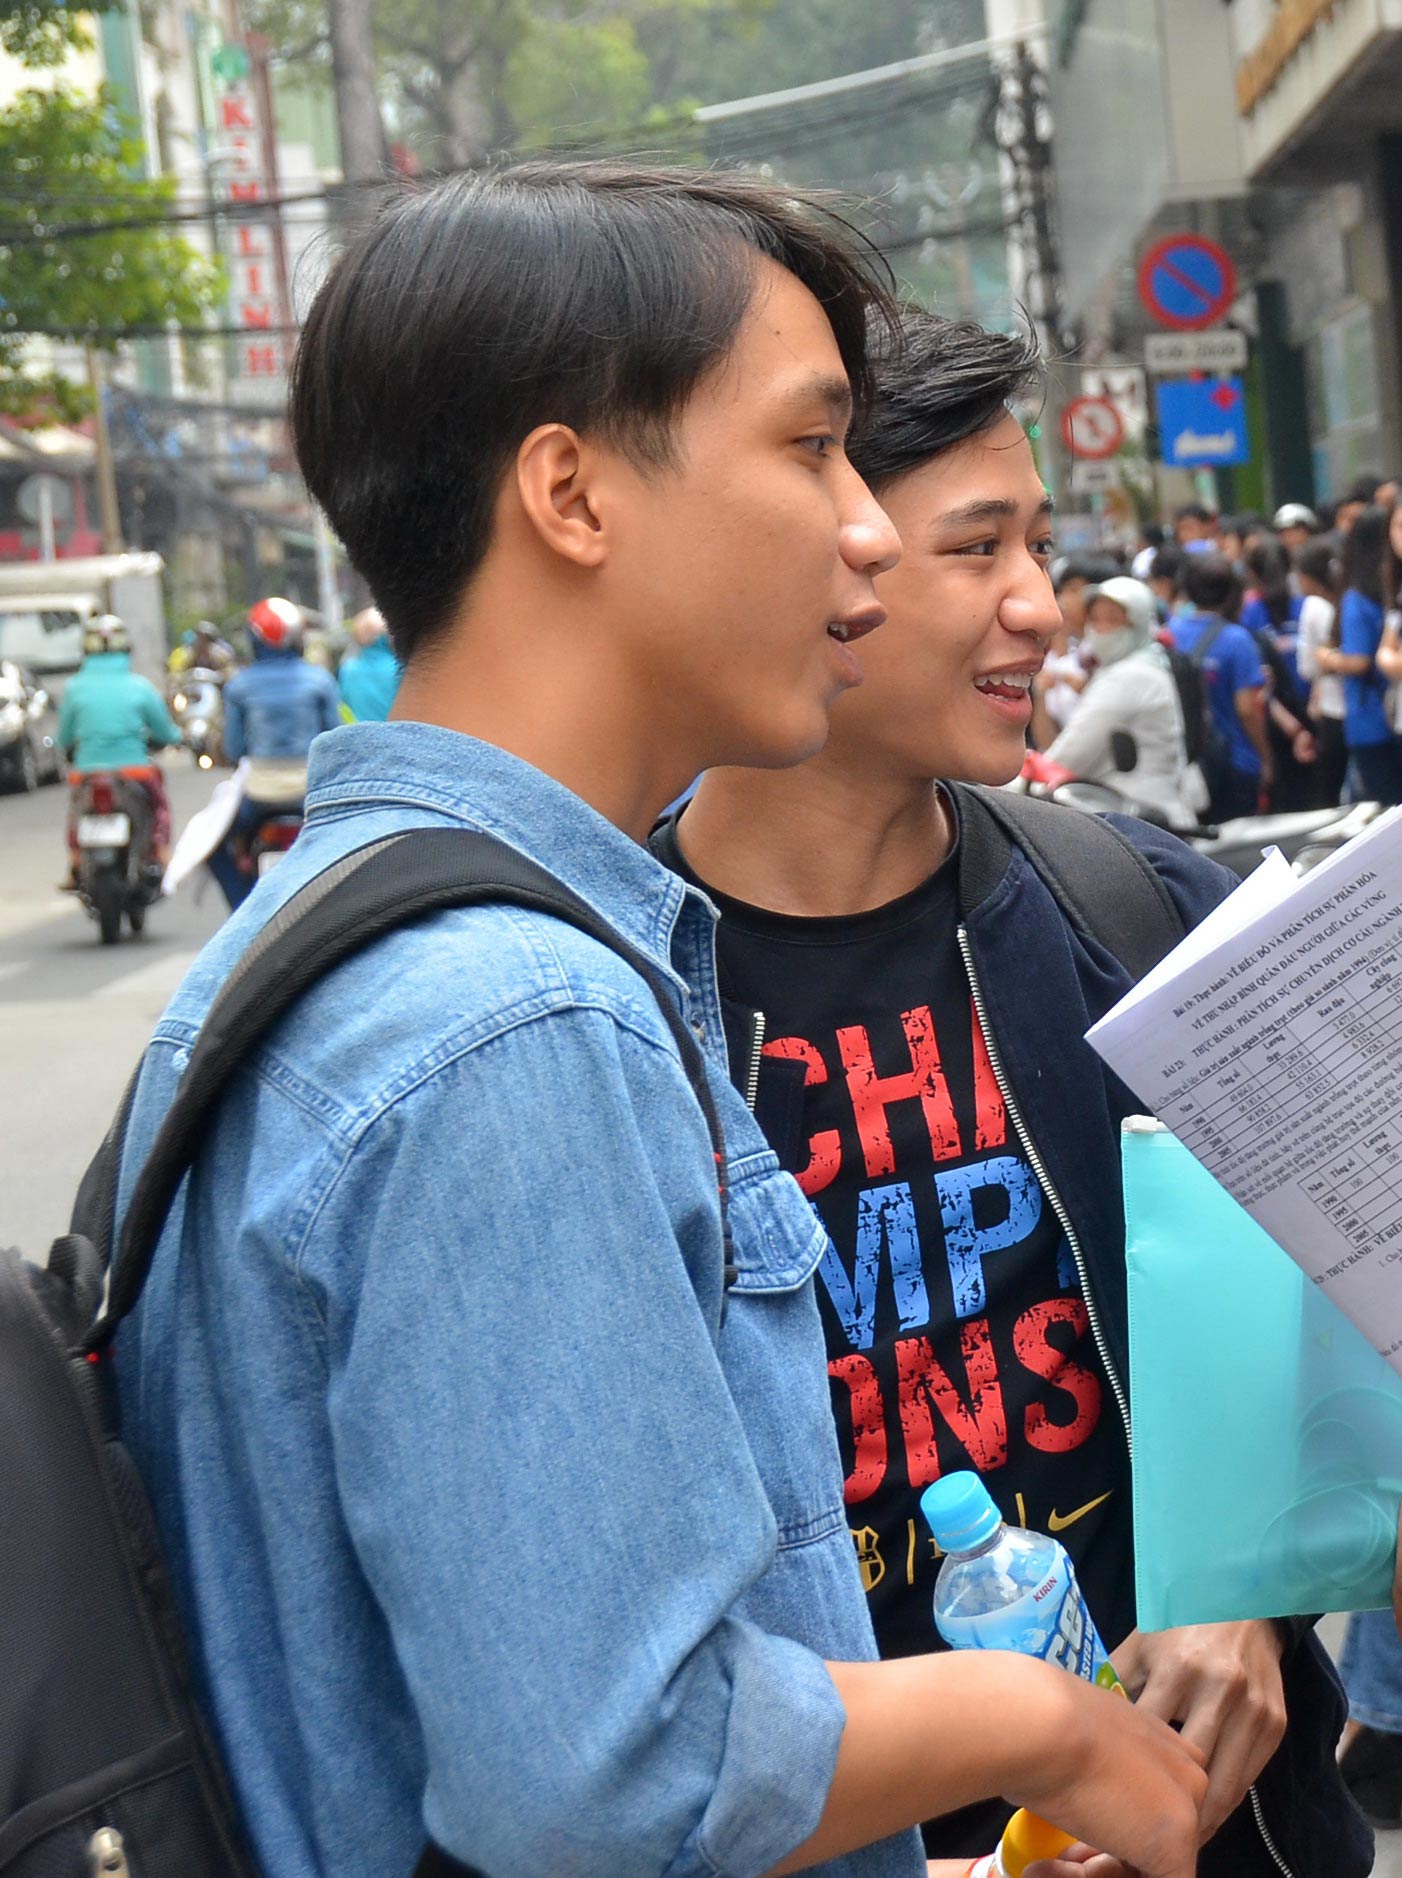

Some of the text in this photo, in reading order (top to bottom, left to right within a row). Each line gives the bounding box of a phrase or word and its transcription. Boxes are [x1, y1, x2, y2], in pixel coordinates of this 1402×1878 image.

[1200, 1008, 1220, 1023] THU
[1385, 1151, 1400, 1164] 100
[1349, 1176, 1364, 1189] 100
[1331, 1206, 1349, 1220] 1995
[812, 1155, 1083, 1350] MP
[1033, 1576, 1058, 1603] KIRIN
